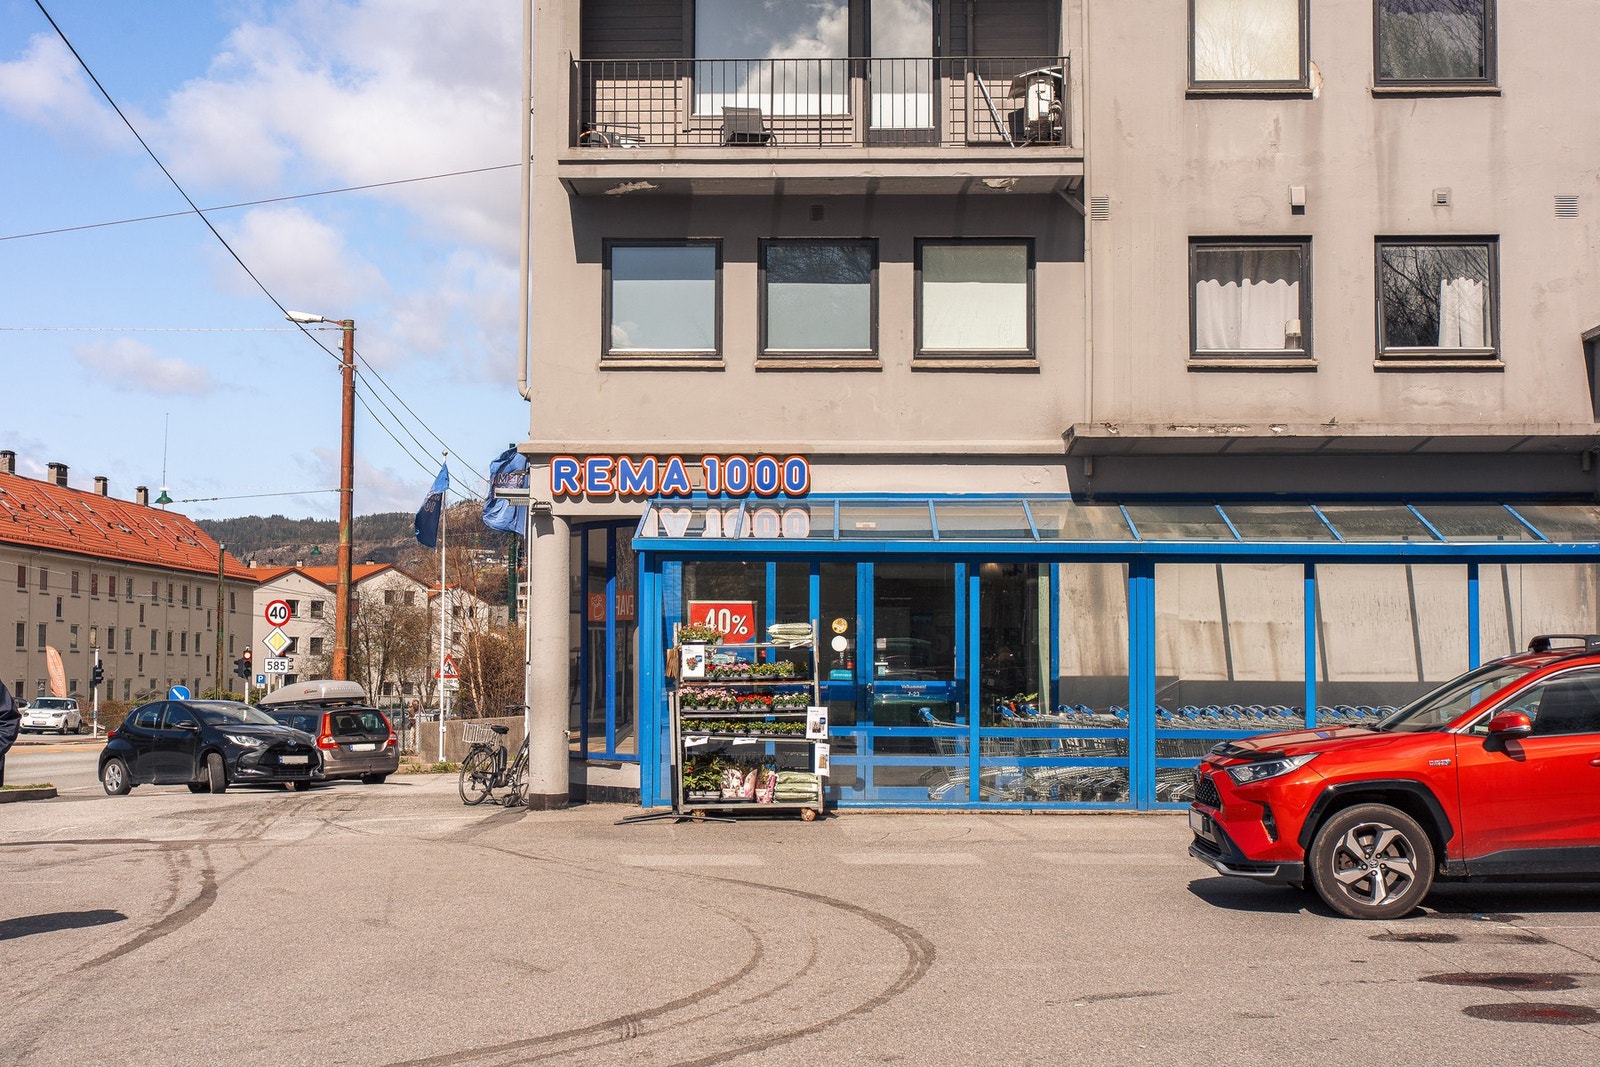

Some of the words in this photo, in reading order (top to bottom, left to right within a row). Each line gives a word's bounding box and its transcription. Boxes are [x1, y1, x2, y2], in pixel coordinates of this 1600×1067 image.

[550, 455, 693, 496] REMA
[701, 455, 810, 496] 1000
[270, 606, 287, 620] 40
[704, 608, 748, 635] 40%
[267, 661, 286, 671] 585
